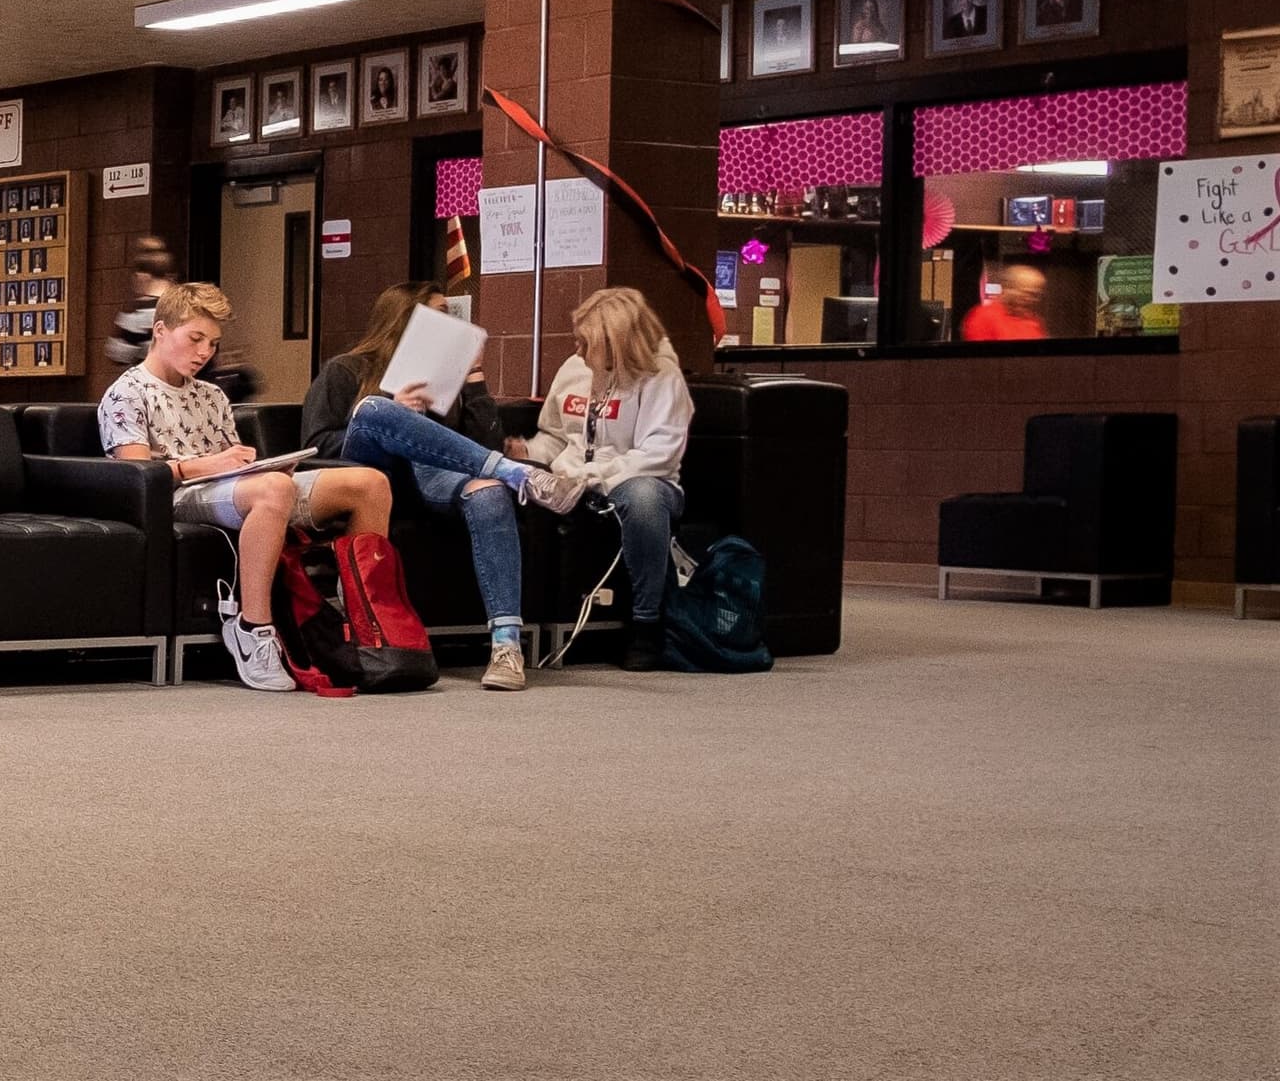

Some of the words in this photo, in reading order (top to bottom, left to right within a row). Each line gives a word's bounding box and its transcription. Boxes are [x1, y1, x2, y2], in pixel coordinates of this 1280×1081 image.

[1196, 178, 1239, 210] Fight
[1201, 208, 1236, 226] Like
[1242, 211, 1252, 223] a
